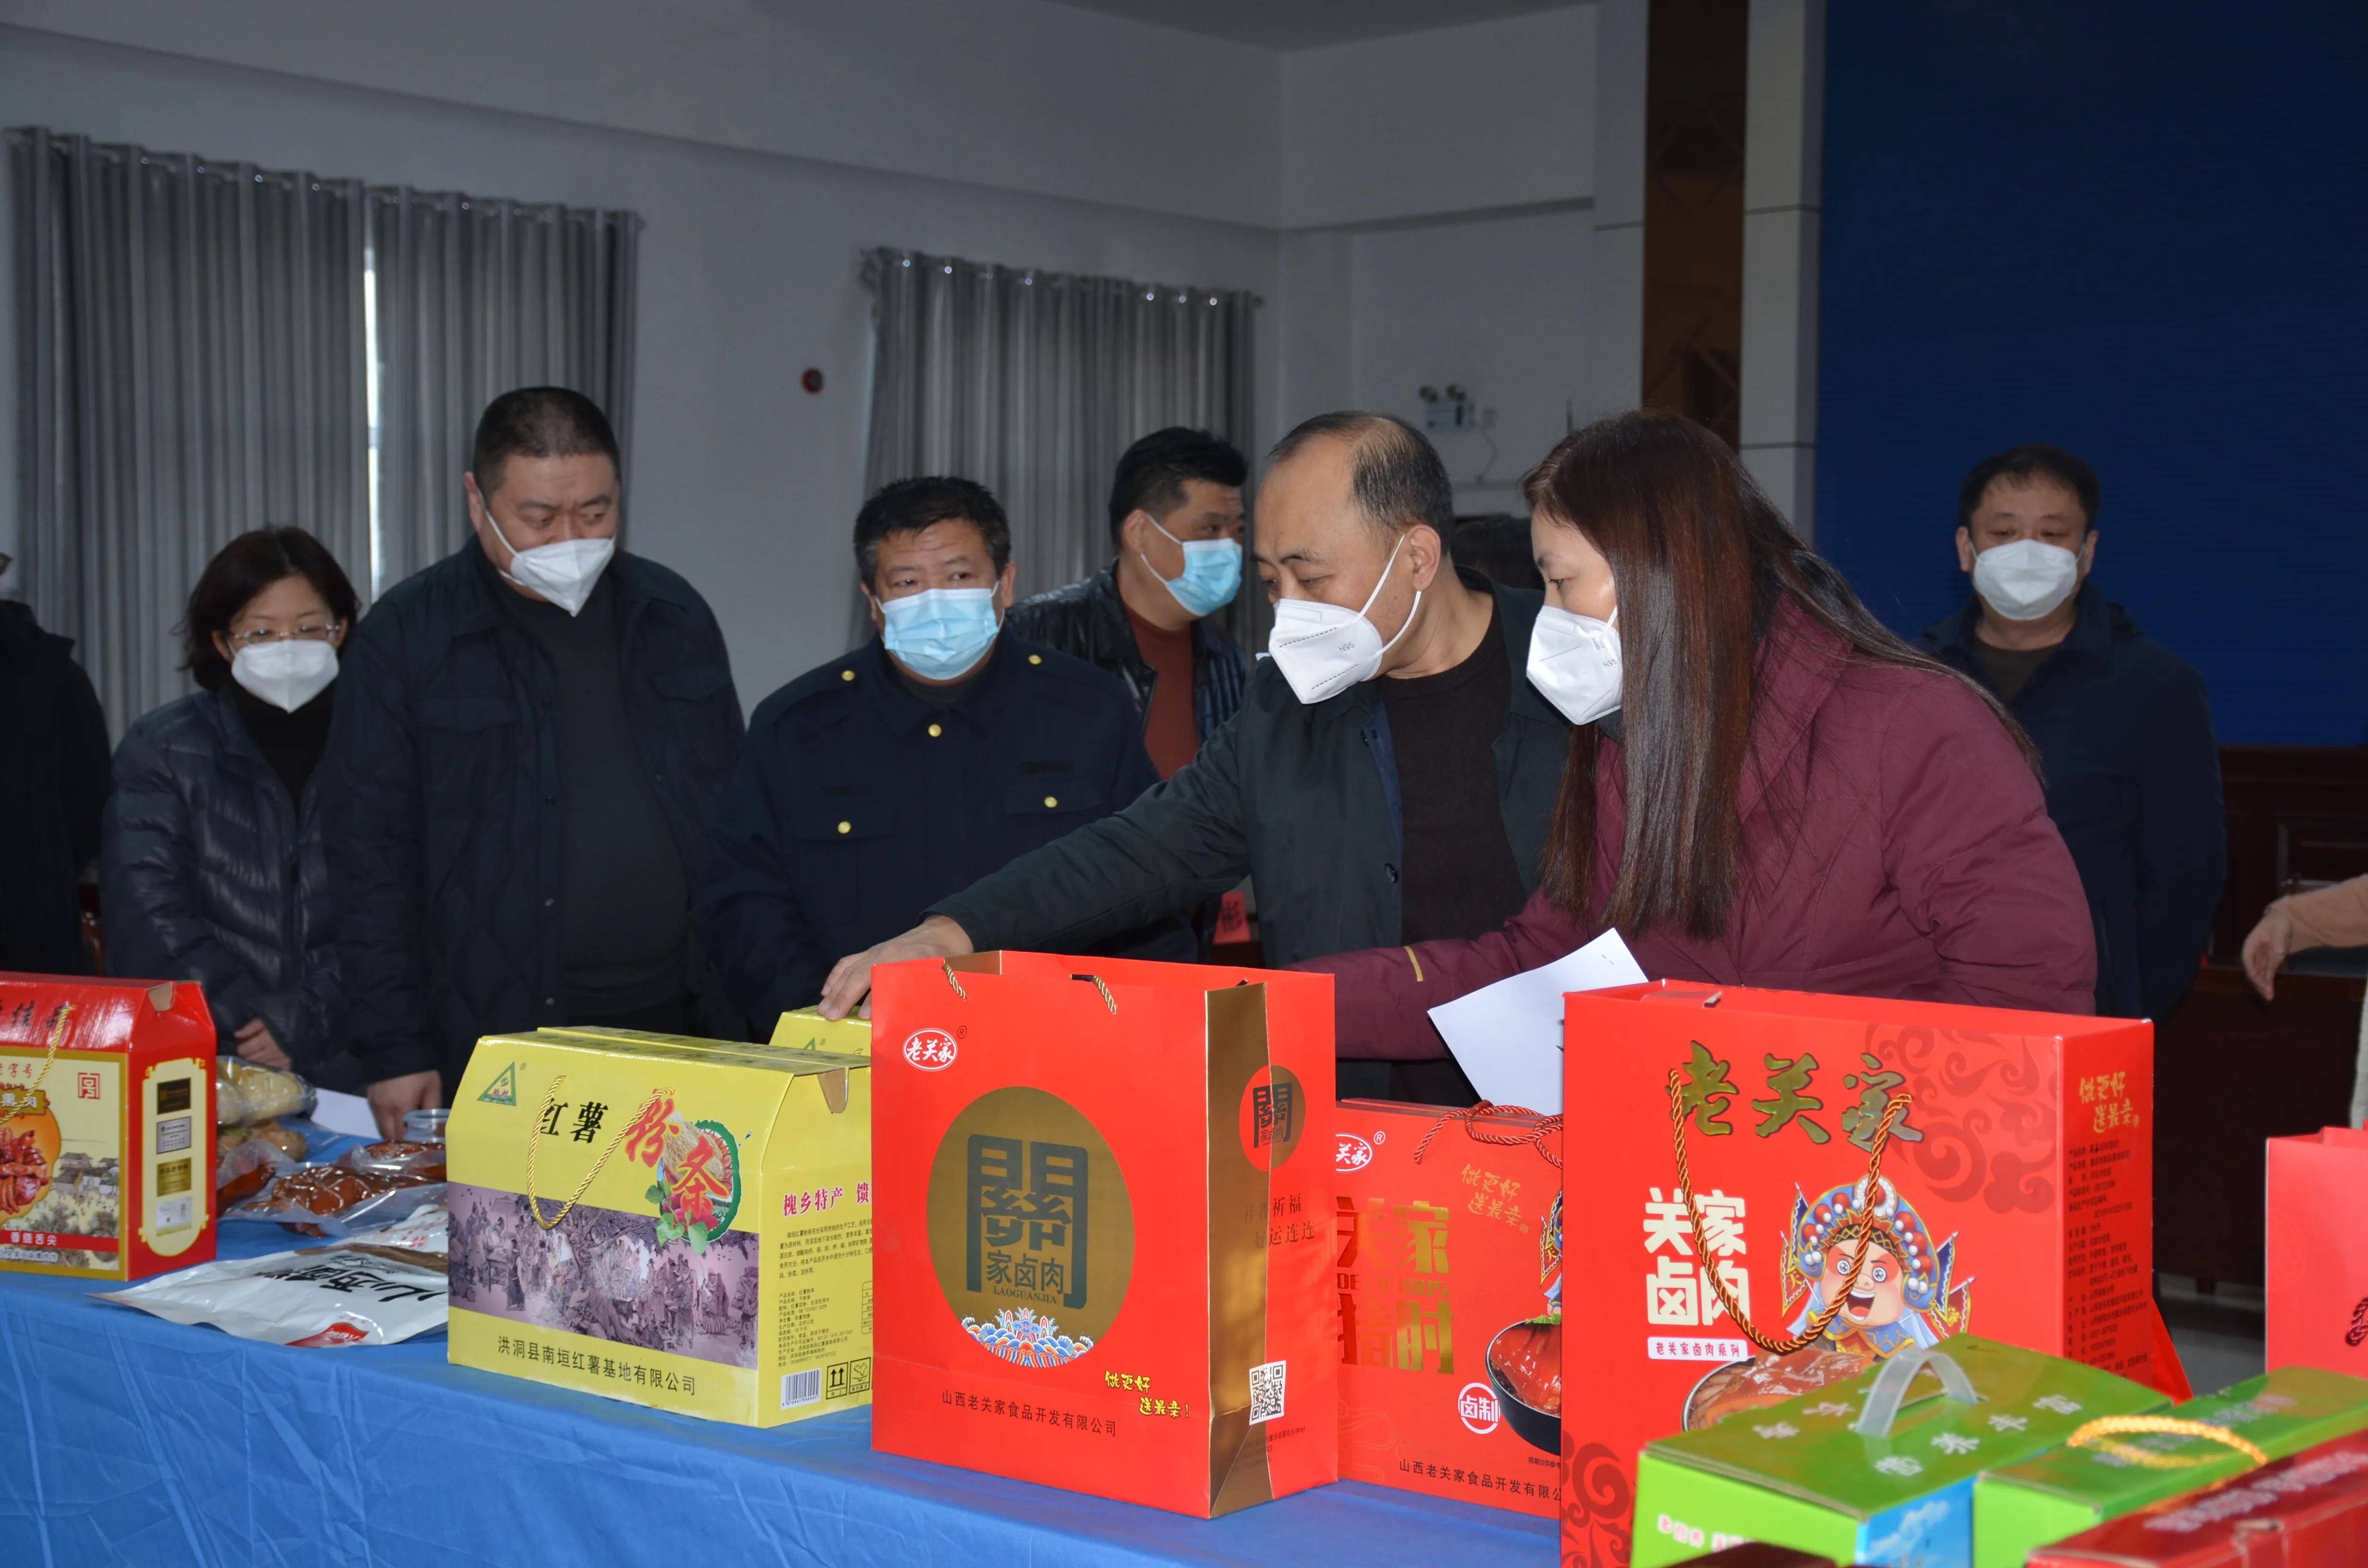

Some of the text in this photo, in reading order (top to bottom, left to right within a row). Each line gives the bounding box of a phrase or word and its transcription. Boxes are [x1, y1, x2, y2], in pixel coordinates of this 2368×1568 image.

[1339, 642, 1355, 653] N95
[1603, 659, 1617, 668] N95
[906, 1036, 954, 1063] 老关家
[1665, 1040, 1924, 1153] 老关家
[534, 1090, 729, 1219] 红薯 粉条
[783, 1181, 873, 1217] 槐乡特产 馈
[1461, 1163, 1521, 1201] 做更好
[1643, 1188, 1746, 1255] 关家
[986, 1250, 1064, 1294] 家卤肉
[993, 1286, 1057, 1304] LAOGUANJIA
[1646, 1255, 1750, 1327] 卤肉
[498, 1335, 696, 1396] 洪洞县南垣红薯基地有限公司
[1656, 1342, 1739, 1357] 老关家卤肉系列
[1105, 1370, 1151, 1394] 做更好
[942, 1389, 1116, 1437] 山西老关家食品开发有限公司
[1460, 1395, 1498, 1422] 卤制
